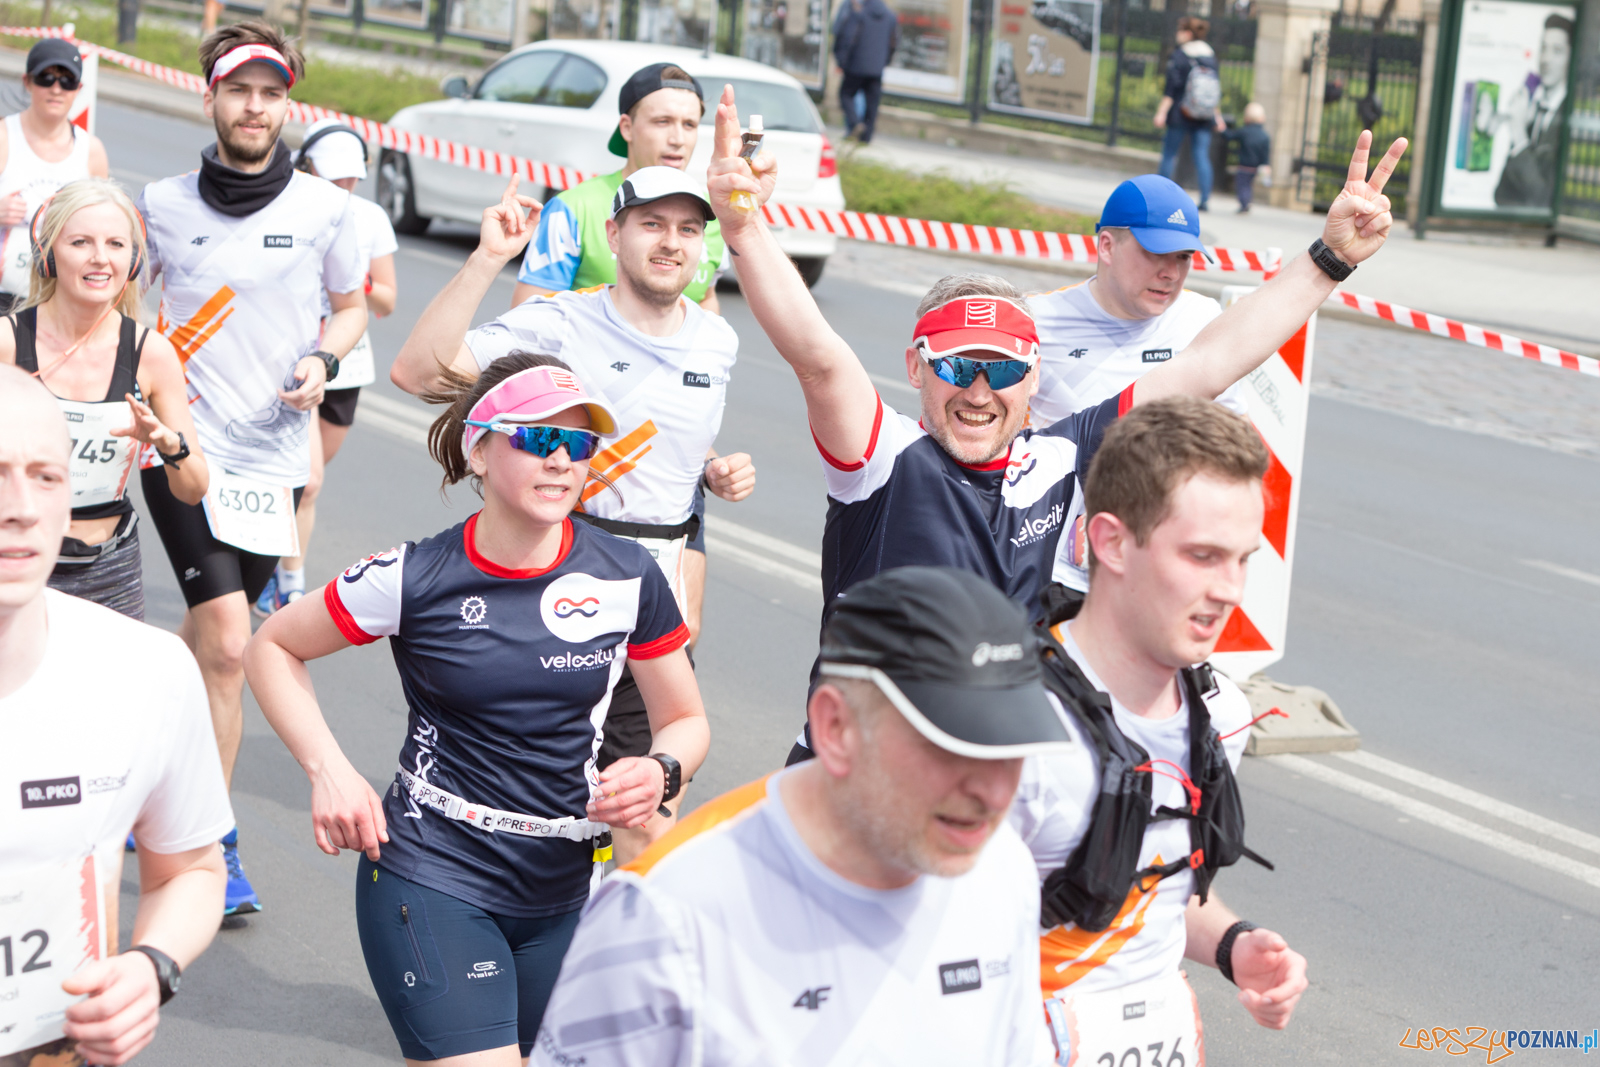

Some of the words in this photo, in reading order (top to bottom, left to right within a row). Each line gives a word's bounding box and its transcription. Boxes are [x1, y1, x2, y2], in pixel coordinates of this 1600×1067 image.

[1167, 217, 1188, 226] adidas
[1068, 348, 1089, 359] 4F
[1145, 351, 1171, 361] 11.PKO
[610, 360, 631, 373] 4F
[218, 487, 277, 515] 6302
[539, 648, 614, 670] velocity
[24, 782, 80, 802] 10.PKO
[792, 986, 833, 1010] 4F
